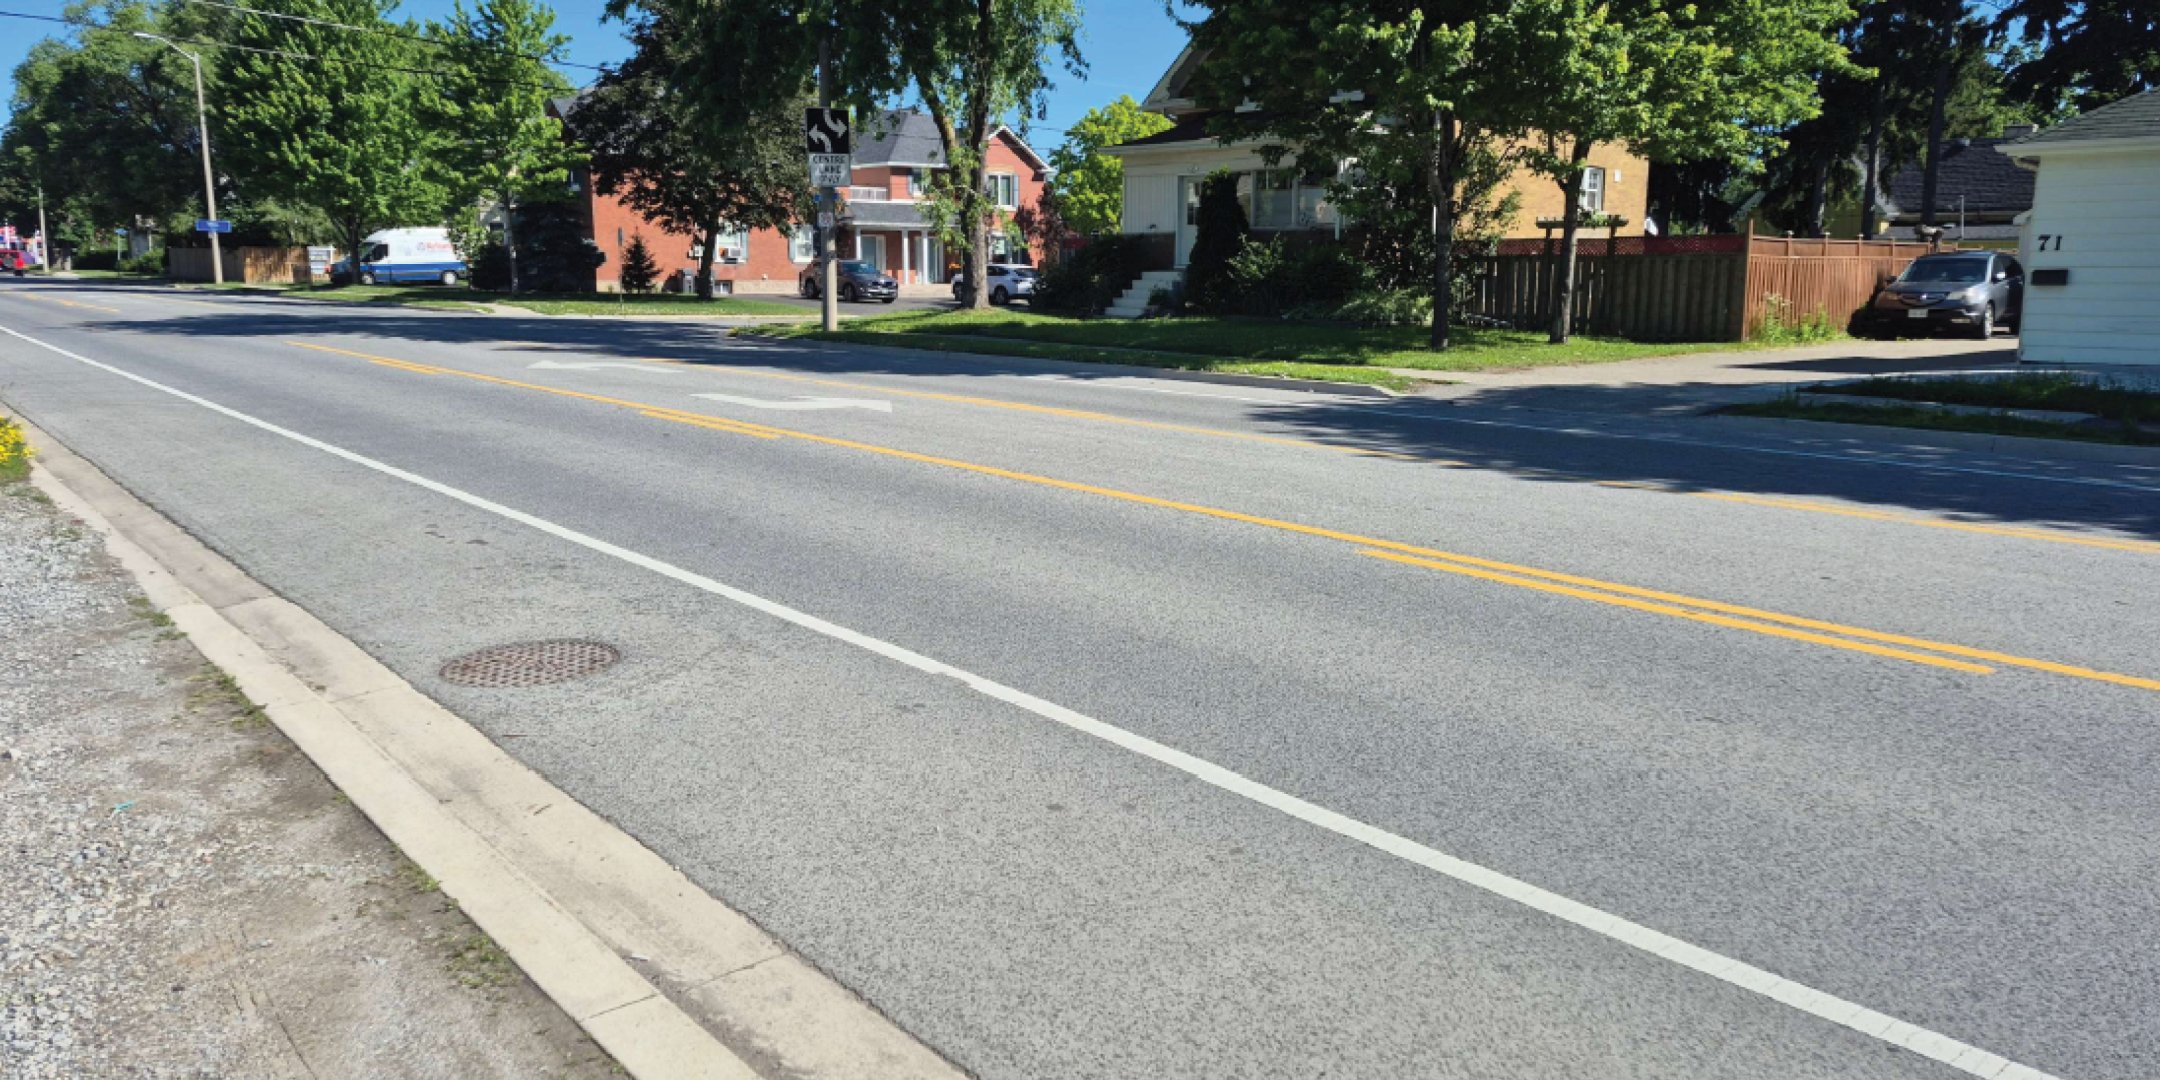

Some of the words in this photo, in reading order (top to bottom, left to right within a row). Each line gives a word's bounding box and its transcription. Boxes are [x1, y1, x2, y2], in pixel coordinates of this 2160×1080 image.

[813, 155, 845, 164] CENTRE
[819, 165, 841, 174] LANE
[2038, 235, 2063, 252] 71
